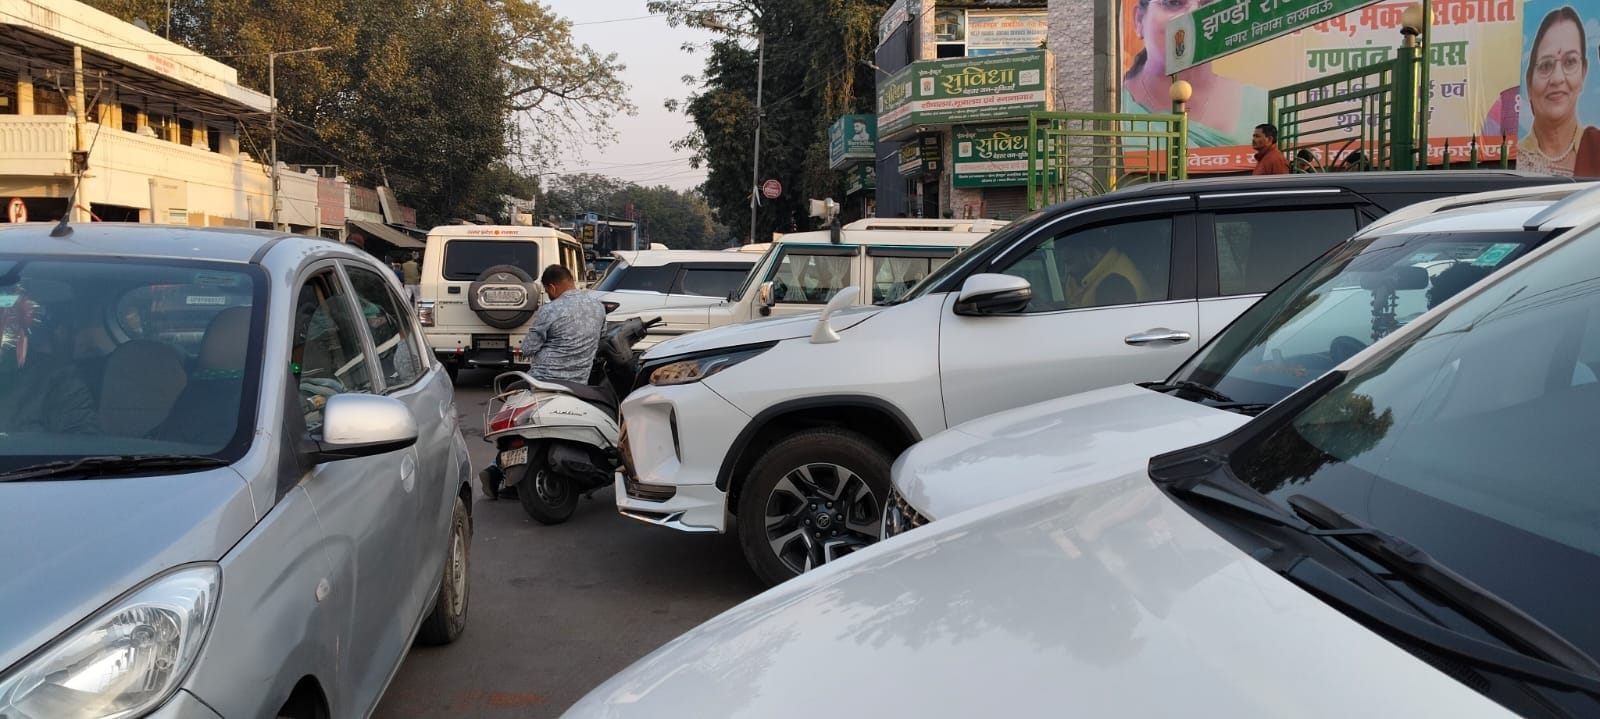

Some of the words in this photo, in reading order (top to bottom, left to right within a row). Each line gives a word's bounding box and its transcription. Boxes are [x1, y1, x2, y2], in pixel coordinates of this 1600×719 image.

[1225, 29, 1248, 46] नगर
[1251, 16, 1284, 38] निगम
[1286, 1, 1333, 25] लखनऊ
[941, 67, 1016, 95] सुविधा
[1440, 79, 1468, 98] एवं
[976, 131, 1029, 159] सुविध
